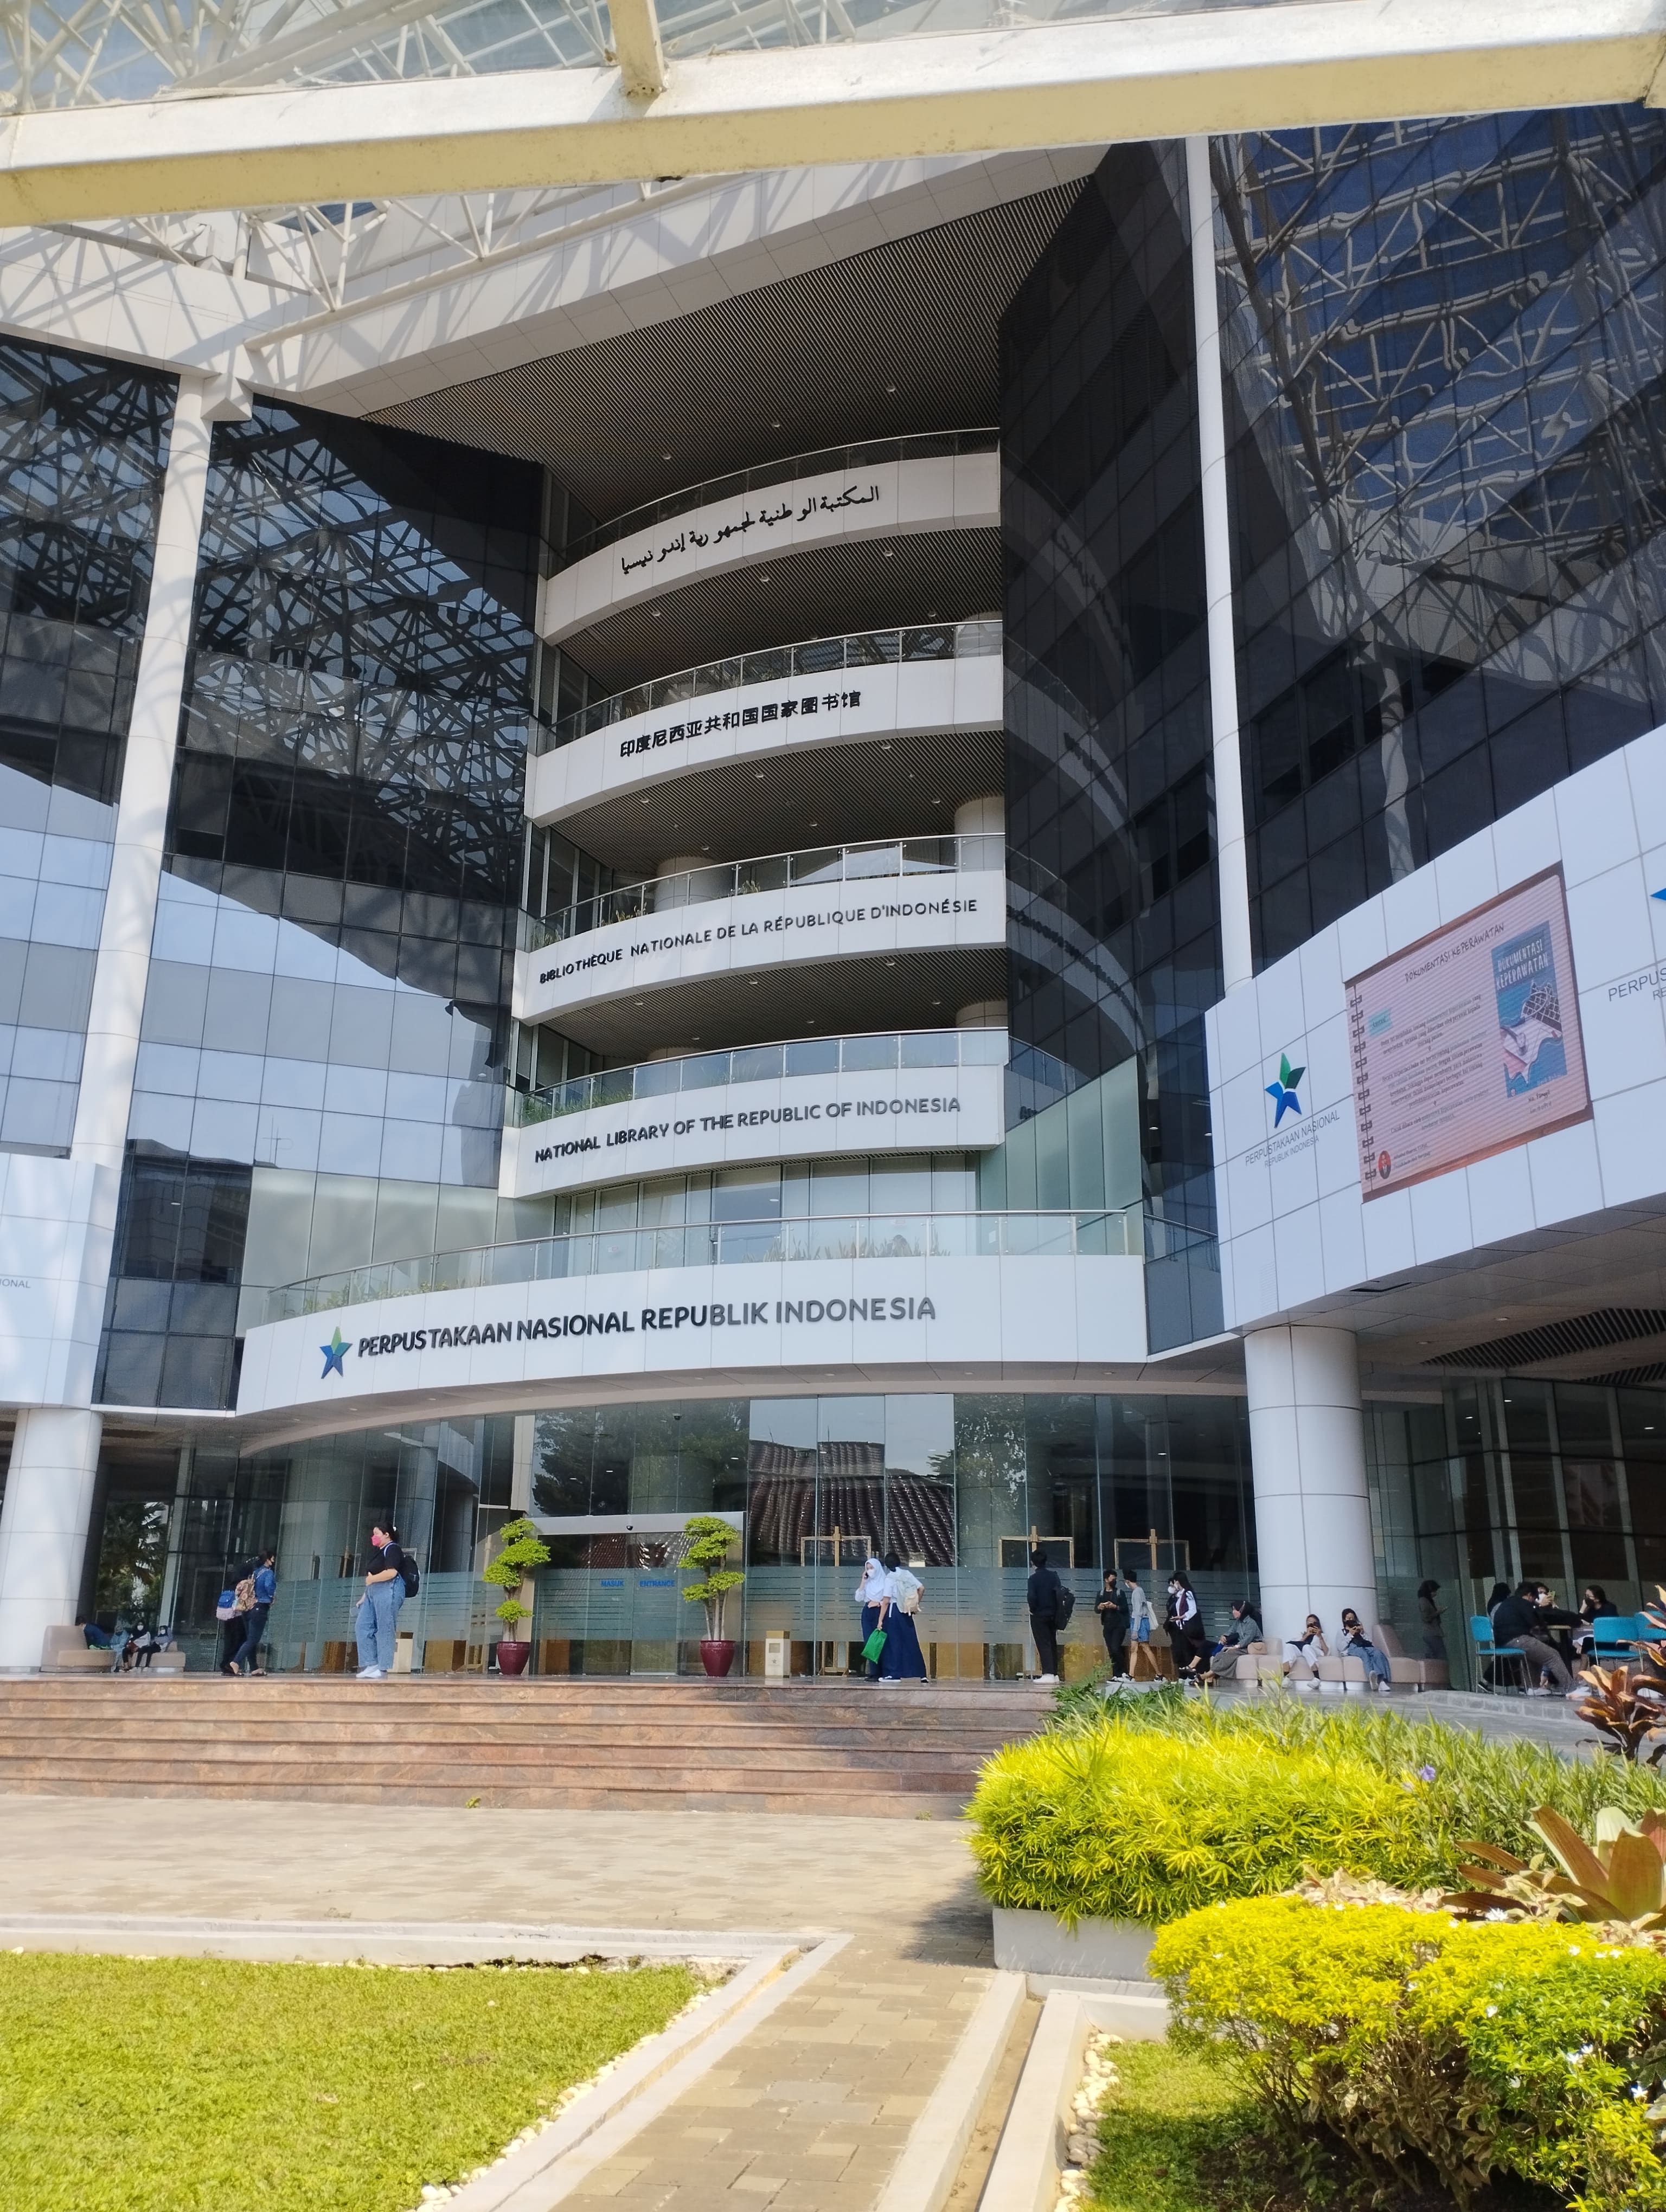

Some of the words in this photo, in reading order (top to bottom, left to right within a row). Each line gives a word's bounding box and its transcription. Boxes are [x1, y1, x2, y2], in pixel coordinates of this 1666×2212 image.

[759, 498, 817, 525] الوطنية
[819, 486, 879, 511] المكتبة
[689, 512, 755, 547] لجمهورية
[621, 533, 685, 574] إندونيسيا
[620, 690, 861, 757] 印度尼西亚共和国国家图书馆
[540, 948, 624, 984] BIBLIOTHÈQUE
[631, 930, 712, 957] NATIONALE
[717, 925, 735, 940] DE
[741, 920, 758, 936] LA
[764, 908, 866, 933] RÉPUBLIQUE
[870, 898, 978, 919] D'INDONÉSIE
[1405, 951, 1451, 983] DOKUMENTASI
[1452, 922, 1504, 956] KEPERAWATAN
[1498, 938, 1543, 972] DOKUMENTASI
[1496, 952, 1549, 990] KEPERAWATAN
[535, 1136, 601, 1163] NATIONAL
[606, 1123, 669, 1147] LIBRARY
[673, 1118, 695, 1135] OF
[700, 1114, 734, 1131] THE
[738, 1104, 821, 1127] REPUBLIC
[825, 1102, 852, 1117] OF
[856, 1097, 961, 1117] INDONESIA
[1245, 1130, 1300, 1167] PERPUSTAKAAN
[1301, 1110, 1340, 1136] NASIONAL
[1265, 1152, 1289, 1168] REPUBLIK
[1290, 1134, 1319, 1155] INDONESIA
[357, 1321, 512, 1358] PERPUSTAKAAN
[516, 1310, 635, 1341] NASIONAL
[642, 1301, 768, 1330] REPUBLIK
[776, 1296, 937, 1324] INDONESIA
[600, 1579, 624, 1587] MASUK
[639, 1579, 676, 1587] ENTRANCE
